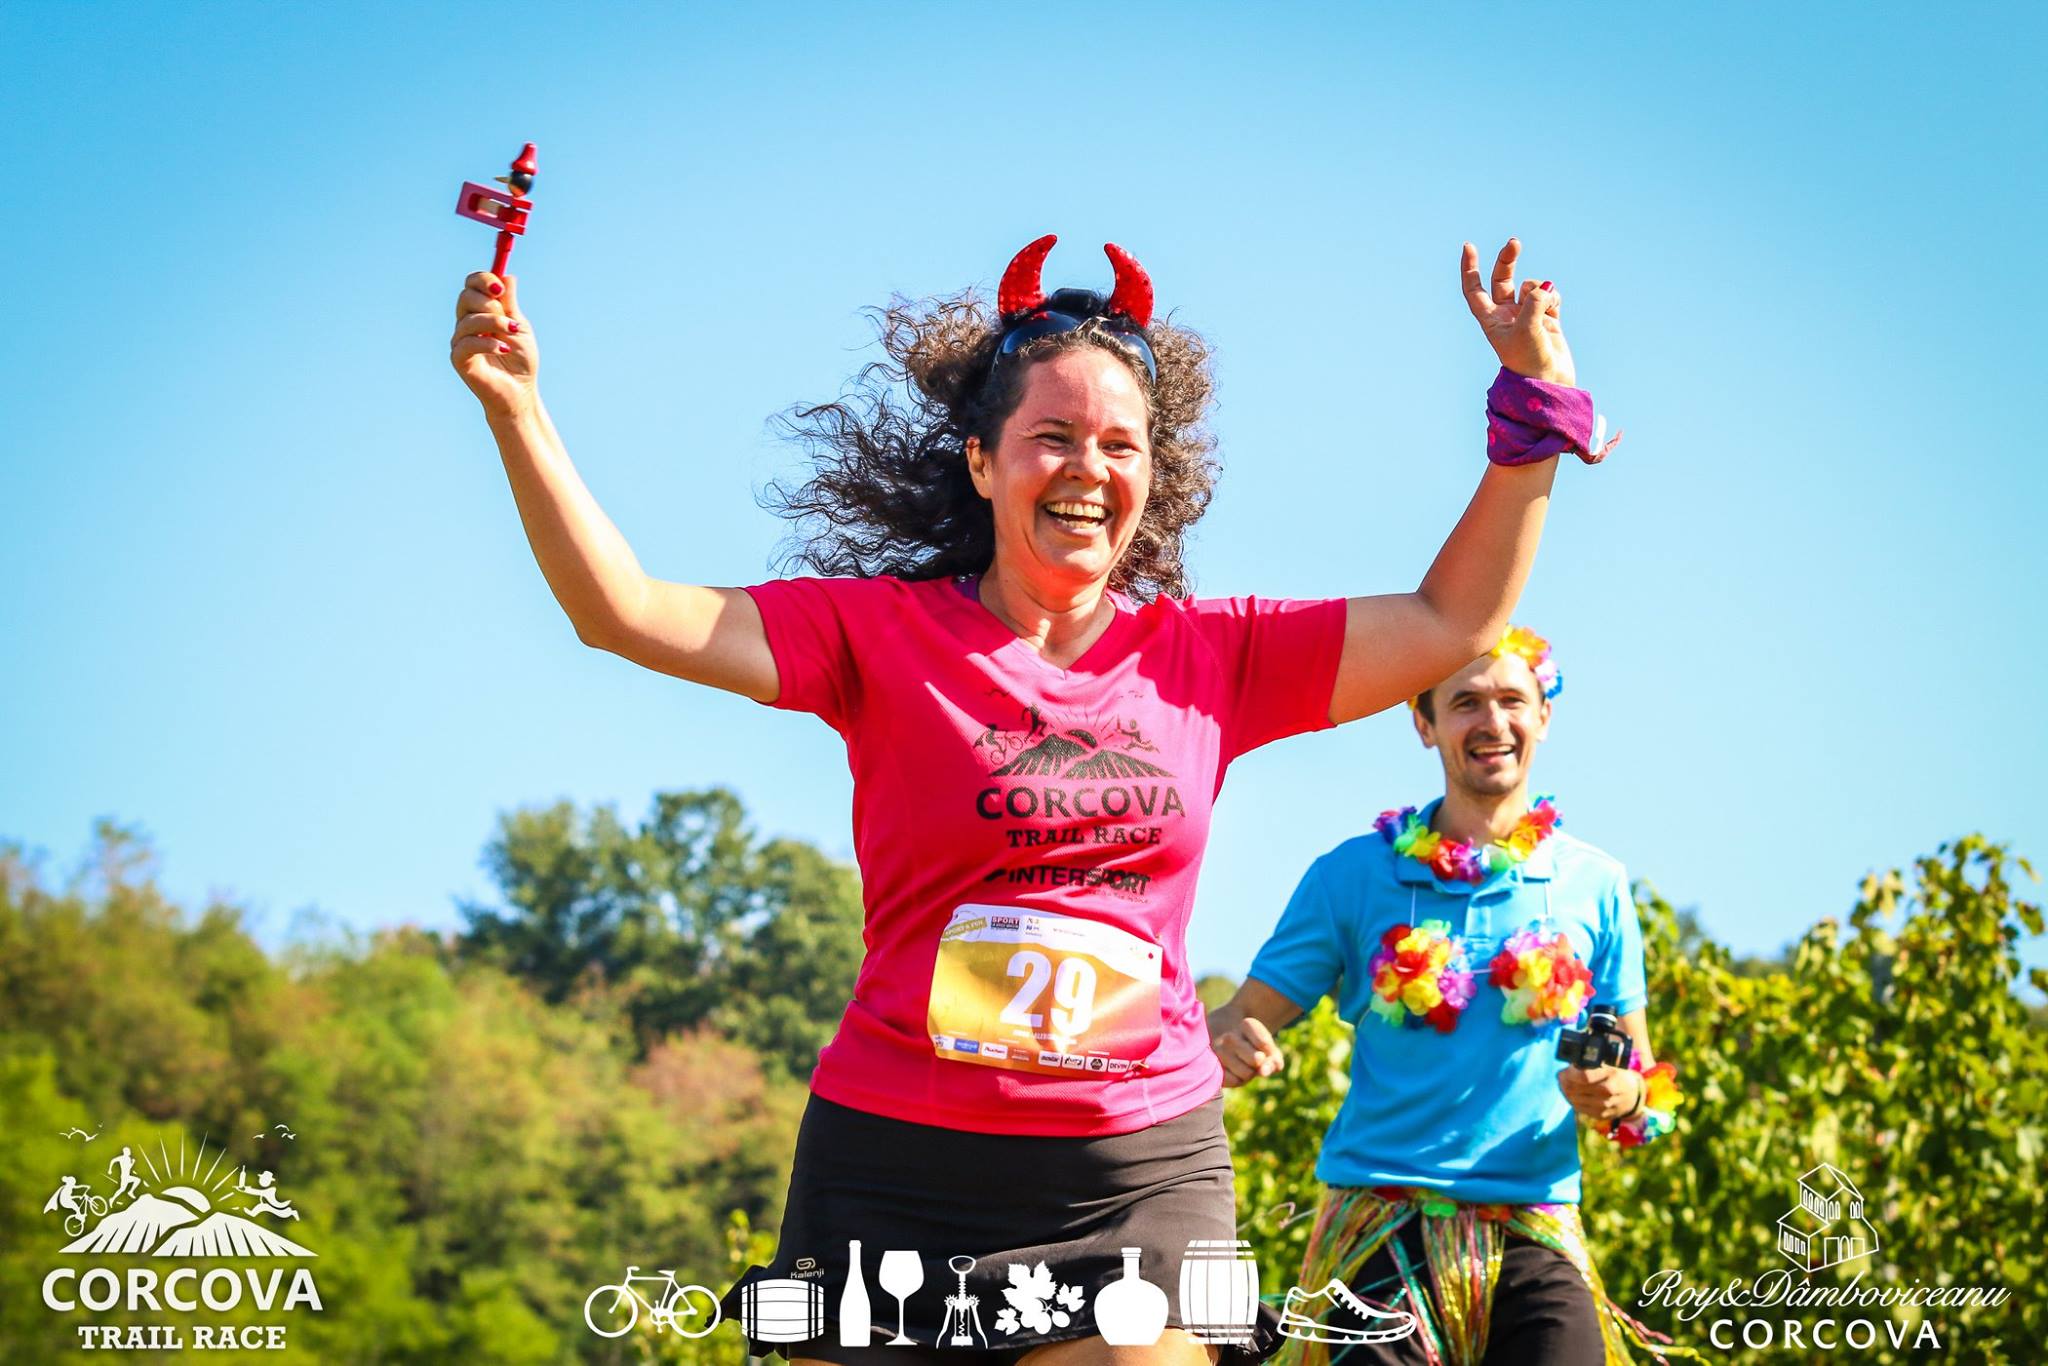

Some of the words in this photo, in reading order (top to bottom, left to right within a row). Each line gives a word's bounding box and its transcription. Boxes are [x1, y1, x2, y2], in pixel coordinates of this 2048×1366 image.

[976, 786, 1186, 820] CORCOVA
[1007, 828, 1084, 848] TRAIL
[1092, 826, 1162, 845] RACE
[1008, 864, 1153, 895] INTERSPORT
[999, 950, 1097, 1038] 29
[790, 1268, 824, 1279] Kalenji
